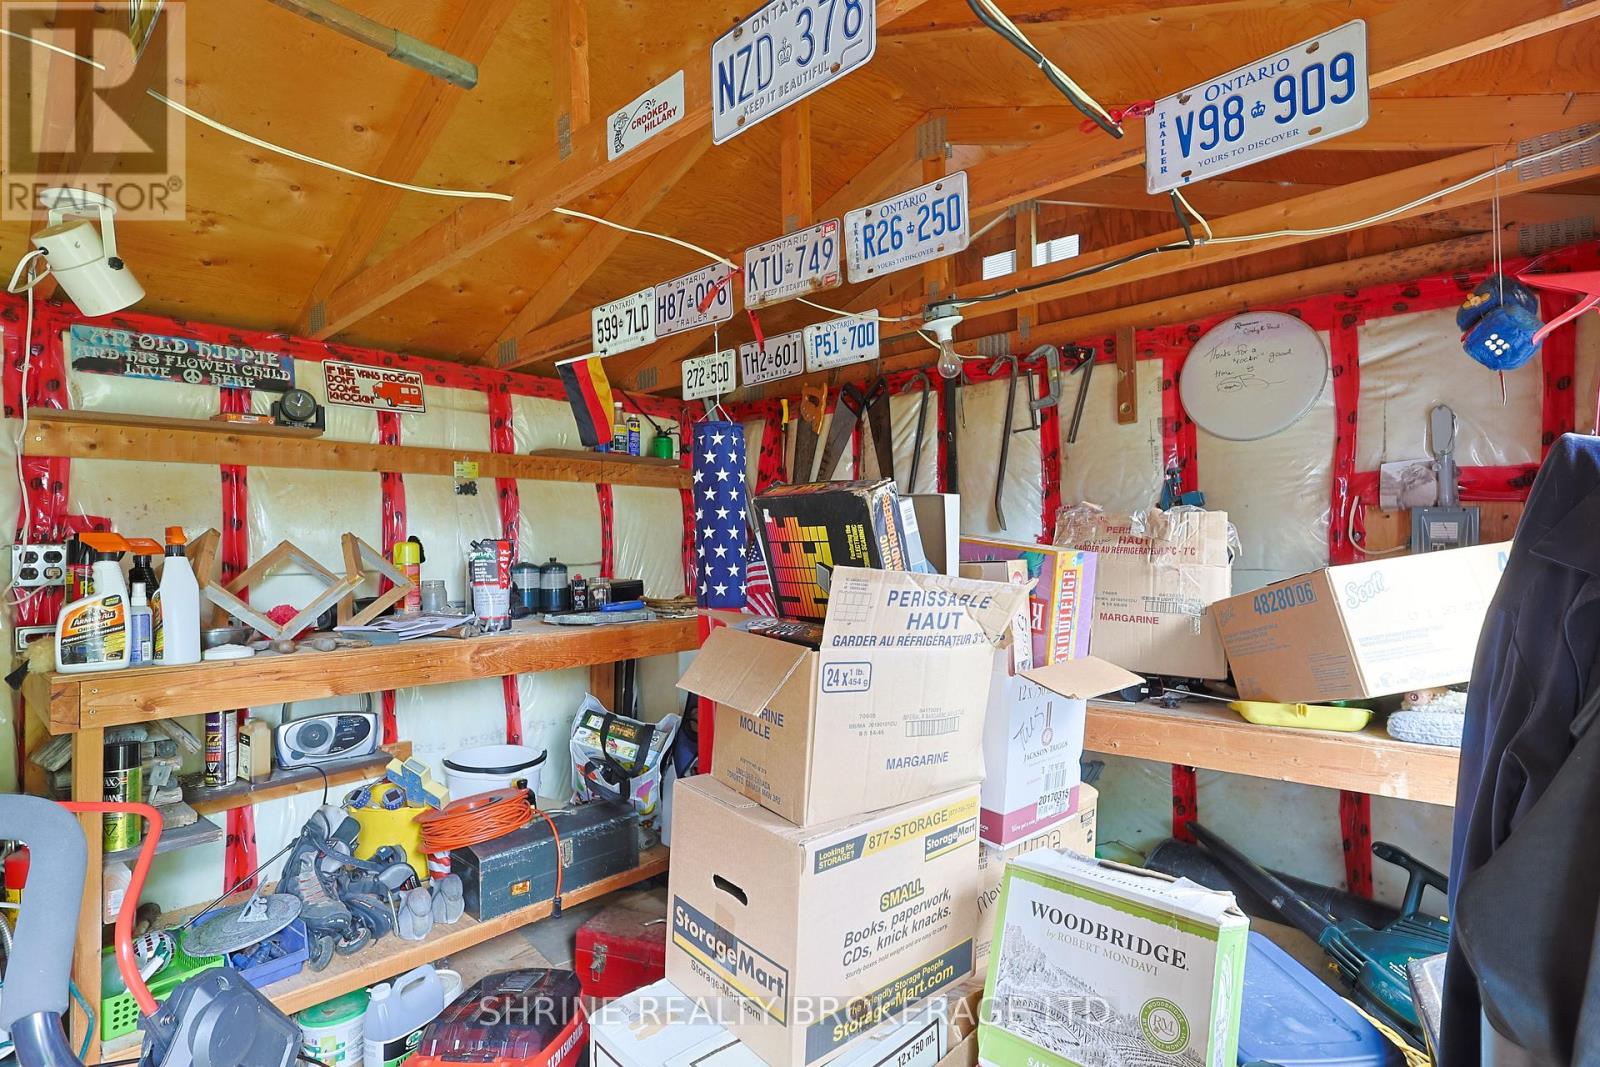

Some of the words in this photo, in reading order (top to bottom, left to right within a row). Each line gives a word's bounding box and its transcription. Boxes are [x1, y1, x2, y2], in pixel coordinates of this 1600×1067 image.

[718, 32, 774, 116] NZD
[796, 0, 864, 67] 378
[743, 96, 766, 117] KEEP
[767, 90, 777, 105] IT
[778, 62, 832, 98] BEAUTIFUL
[1204, 57, 1290, 102] ONTARIO
[631, 101, 669, 130] CROOKED
[644, 105, 678, 133] HILLARY
[1175, 95, 1245, 159] V98
[1273, 52, 1356, 125] 909
[1159, 112, 1168, 174] TRAILER
[1197, 153, 1229, 168] YOURS
[1231, 147, 1245, 158] TO
[1248, 128, 1300, 152] DISCOVER
[880, 192, 927, 218] ONTARIO
[863, 215, 904, 260] R26
[917, 193, 962, 242] 250
[770, 233, 808, 252] ONTARIO
[853, 222, 861, 270] TRAILER
[748, 252, 783, 293] KTU
[796, 237, 834, 279] 749
[876, 259, 895, 271] YOURS
[904, 247, 934, 264] DISCOVER
[676, 272, 706, 289] ONTARIO
[609, 298, 635, 314] ONTARIO
[657, 290, 685, 325] H87
[676, 312, 708, 328] TRAILER
[597, 315, 618, 344] 599
[625, 304, 649, 335] 7LD
[826, 319, 855, 333] ONTARIO
[139, 334, 189, 354] OLD
[195, 342, 280, 368] HIPPIE
[815, 331, 839, 358] P51
[849, 322, 875, 350] 700
[126, 350, 160, 365] HIS
[166, 355, 238, 375] FLOWER
[242, 365, 291, 382] CHILD
[326, 365, 335, 374] IF
[337, 367, 354, 378] THE
[743, 351, 767, 375] TH2
[775, 341, 798, 368] 601
[125, 363, 171, 378] LIVE
[210, 373, 255, 388] HERE
[328, 383, 360, 394] COME
[687, 367, 705, 389] 272
[757, 368, 787, 381] ONTARIO
[882, 494, 899, 546] ROBBERS
[1101, 546, 1110, 554] AU
[887, 590, 992, 609] PERISSABLE
[1345, 570, 1384, 609] Scott
[906, 612, 963, 630] HAUT
[1099, 612, 1160, 625] MARGARINE
[832, 635, 877, 647] GARDER
[880, 635, 895, 646] AU
[899, 632, 971, 647] RÉFRIGÉRATEUR
[826, 669, 840, 687] 24
[841, 672, 848, 686] x
[849, 678, 861, 686] 454
[740, 715, 771, 740] MOLLE
[886, 751, 949, 770] MARGARINE
[1038, 789, 1069, 806] 20170315
[868, 809, 948, 850] 877-STORAGE
[926, 823, 975, 851] StorageMart
[818, 851, 854, 870] STORAGE?
[819, 846, 845, 860] Looking
[846, 842, 855, 851] for
[880, 878, 924, 912] SMALL
[844, 920, 887, 949] Books,
[891, 887, 952, 930] paperwork,
[843, 946, 873, 967] CDs,
[877, 925, 908, 951] knick
[911, 906, 952, 934] knacks.
[675, 905, 784, 998] StorageMart
[1045, 929, 1056, 942] by
[1057, 931, 1099, 953] ROBERT
[1102, 950, 1158, 977] MONDAVI
[845, 966, 862, 979] Sturdy
[863, 960, 877, 971] boxes
[849, 1002, 862, 1015] The
[864, 986, 893, 1007] Friendly
[895, 972, 921, 991] Storage
[922, 959, 944, 976] People
[833, 965, 954, 1042] Storage-Mart.com
[925, 1031, 935, 1047] mL
